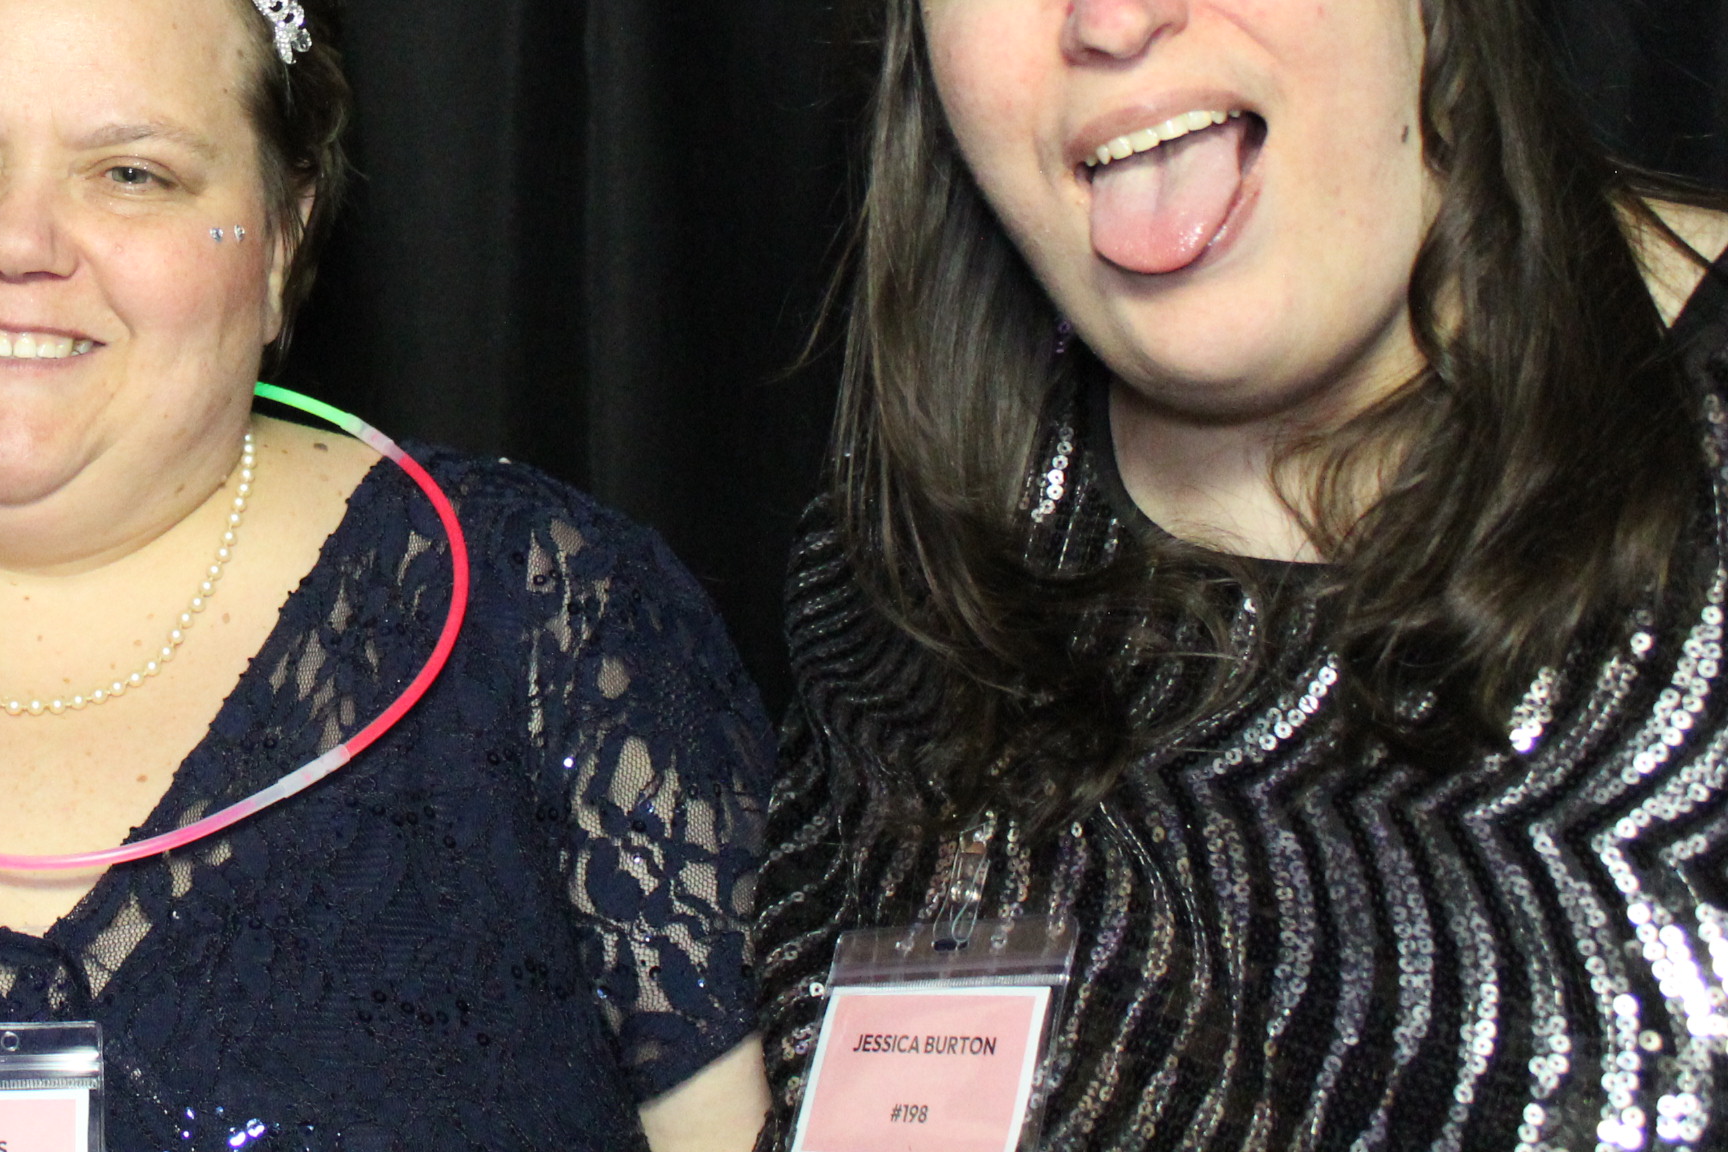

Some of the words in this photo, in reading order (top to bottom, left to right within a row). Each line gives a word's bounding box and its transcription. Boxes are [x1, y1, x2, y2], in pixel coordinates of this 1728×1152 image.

[853, 1034, 919, 1053] JESSICA
[925, 1036, 997, 1055] BURTON
[890, 1104, 928, 1123] #198
